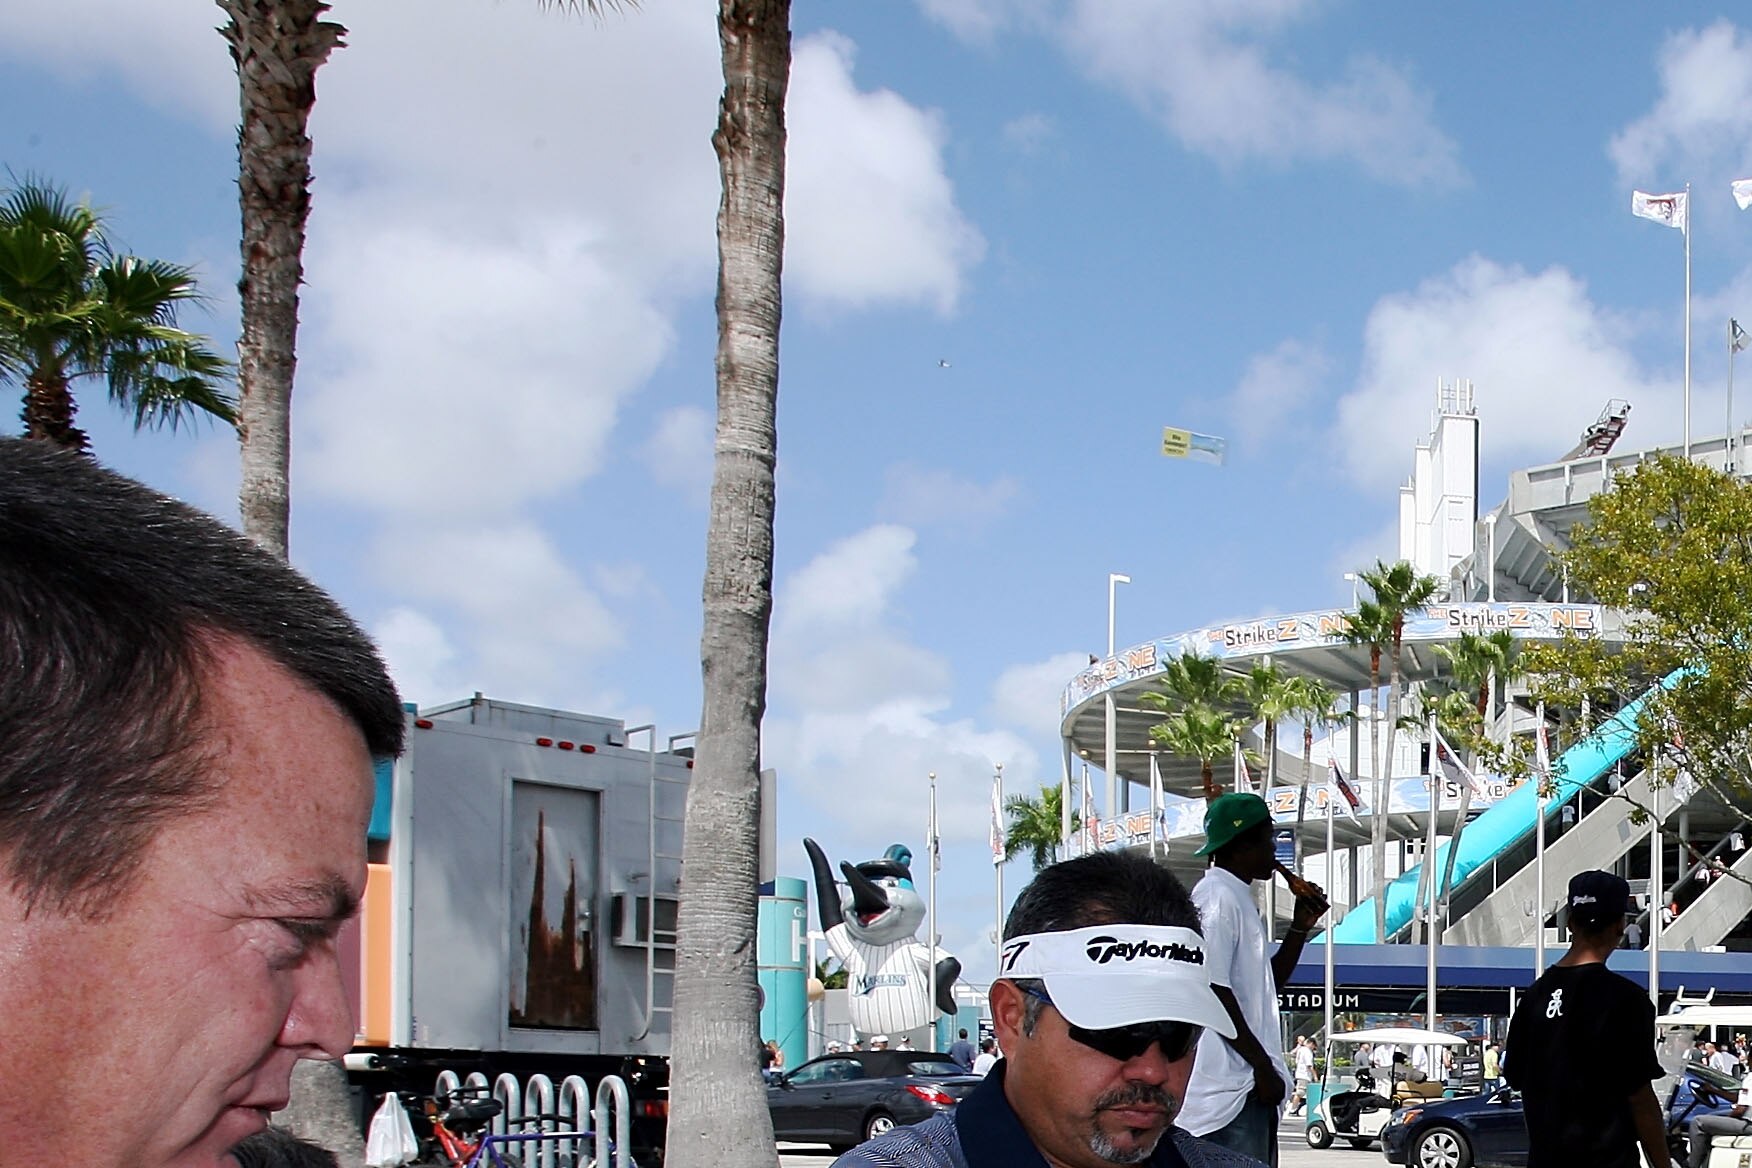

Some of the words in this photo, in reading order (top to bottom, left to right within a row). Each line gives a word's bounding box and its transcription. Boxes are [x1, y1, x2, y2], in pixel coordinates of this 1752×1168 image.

[1448, 608, 1507, 629] Strike
[1224, 621, 1276, 649] Strike
[1277, 994, 1359, 1008] STADUM
